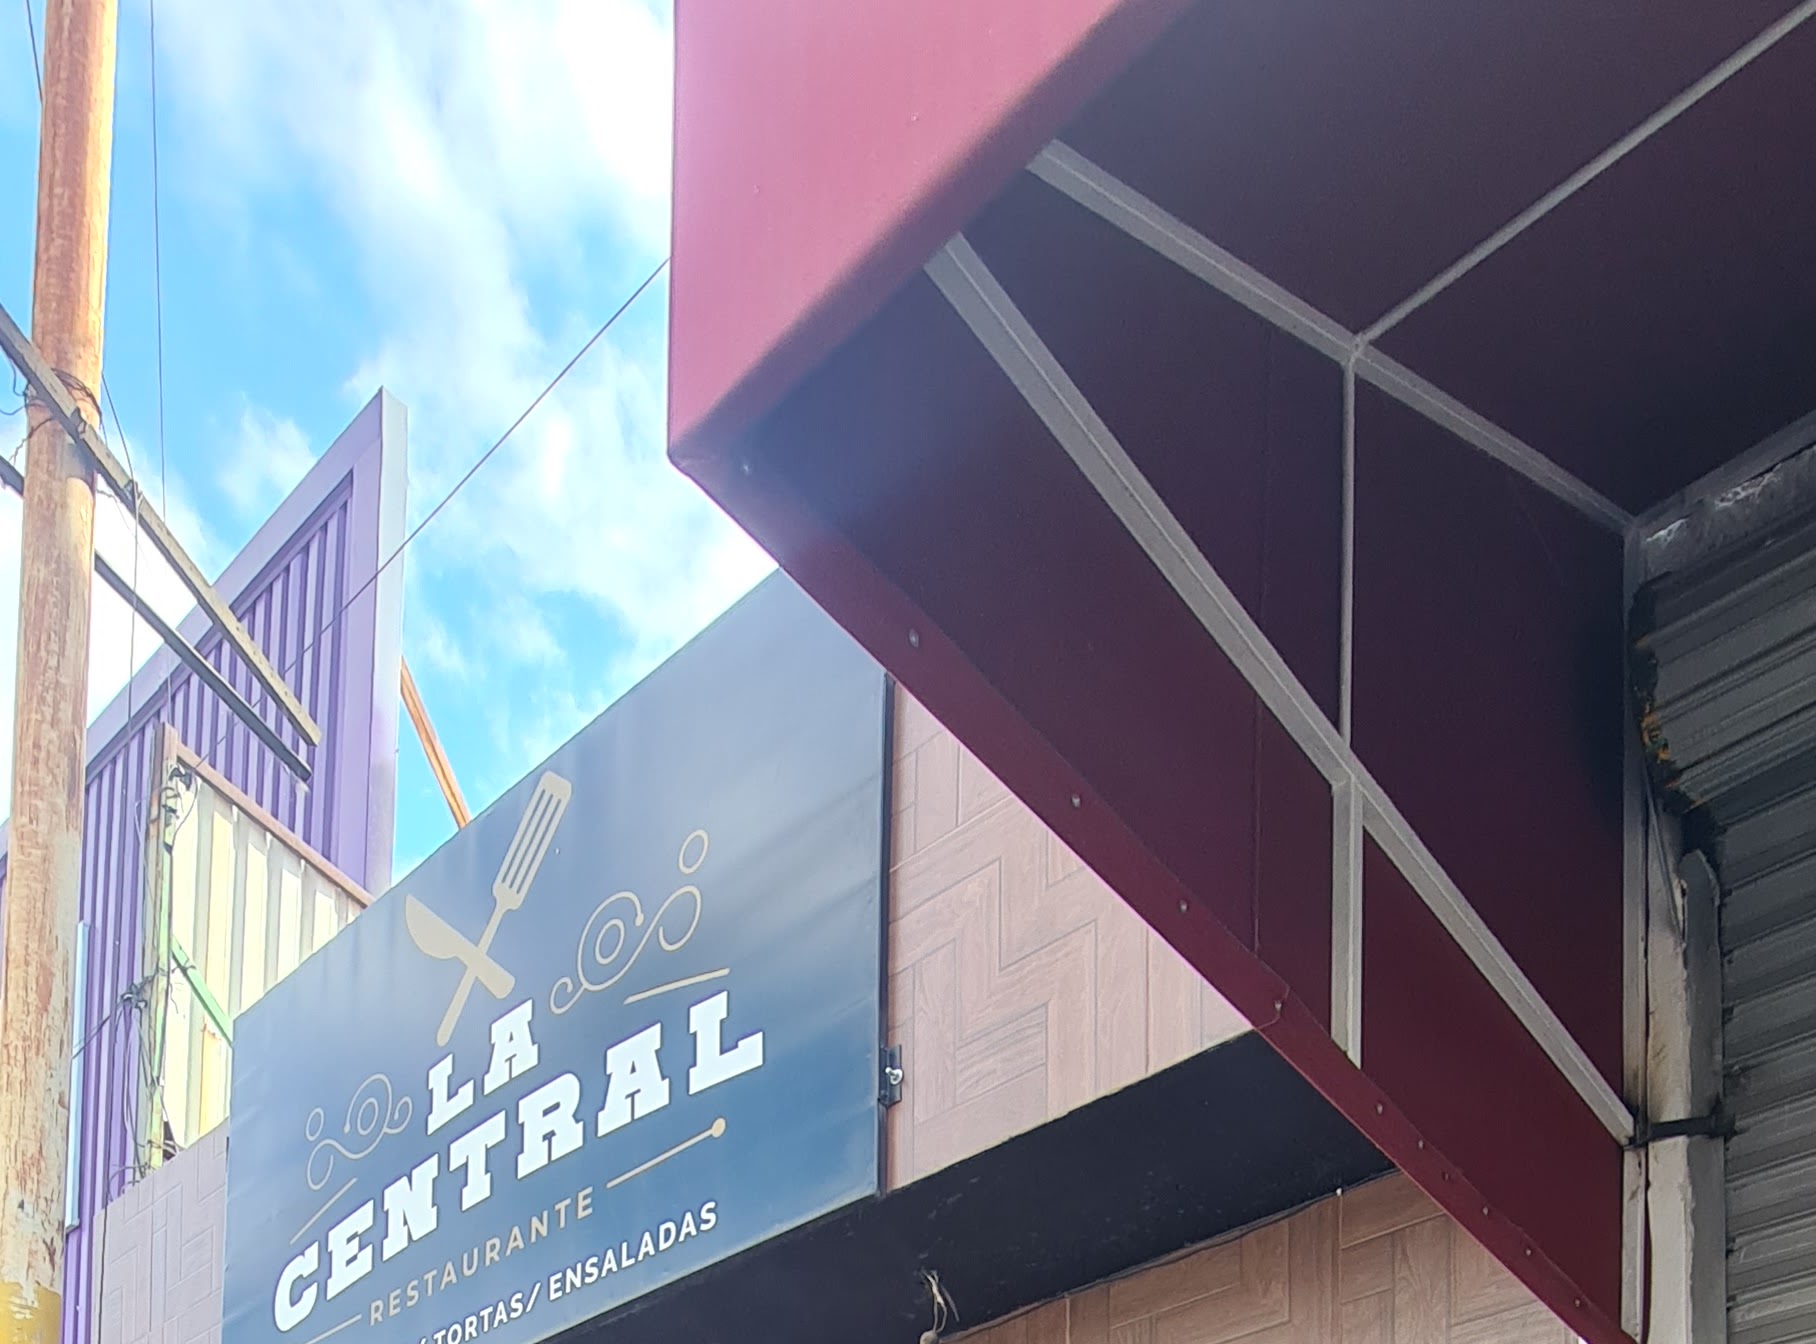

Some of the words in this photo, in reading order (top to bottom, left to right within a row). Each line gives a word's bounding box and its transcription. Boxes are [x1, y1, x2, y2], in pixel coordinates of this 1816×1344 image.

[427, 998, 539, 1136] LA
[273, 990, 764, 1333] CENTRAL
[370, 1186, 594, 1326] RESTAURANTE
[548, 1200, 718, 1301] ENSALADAS
